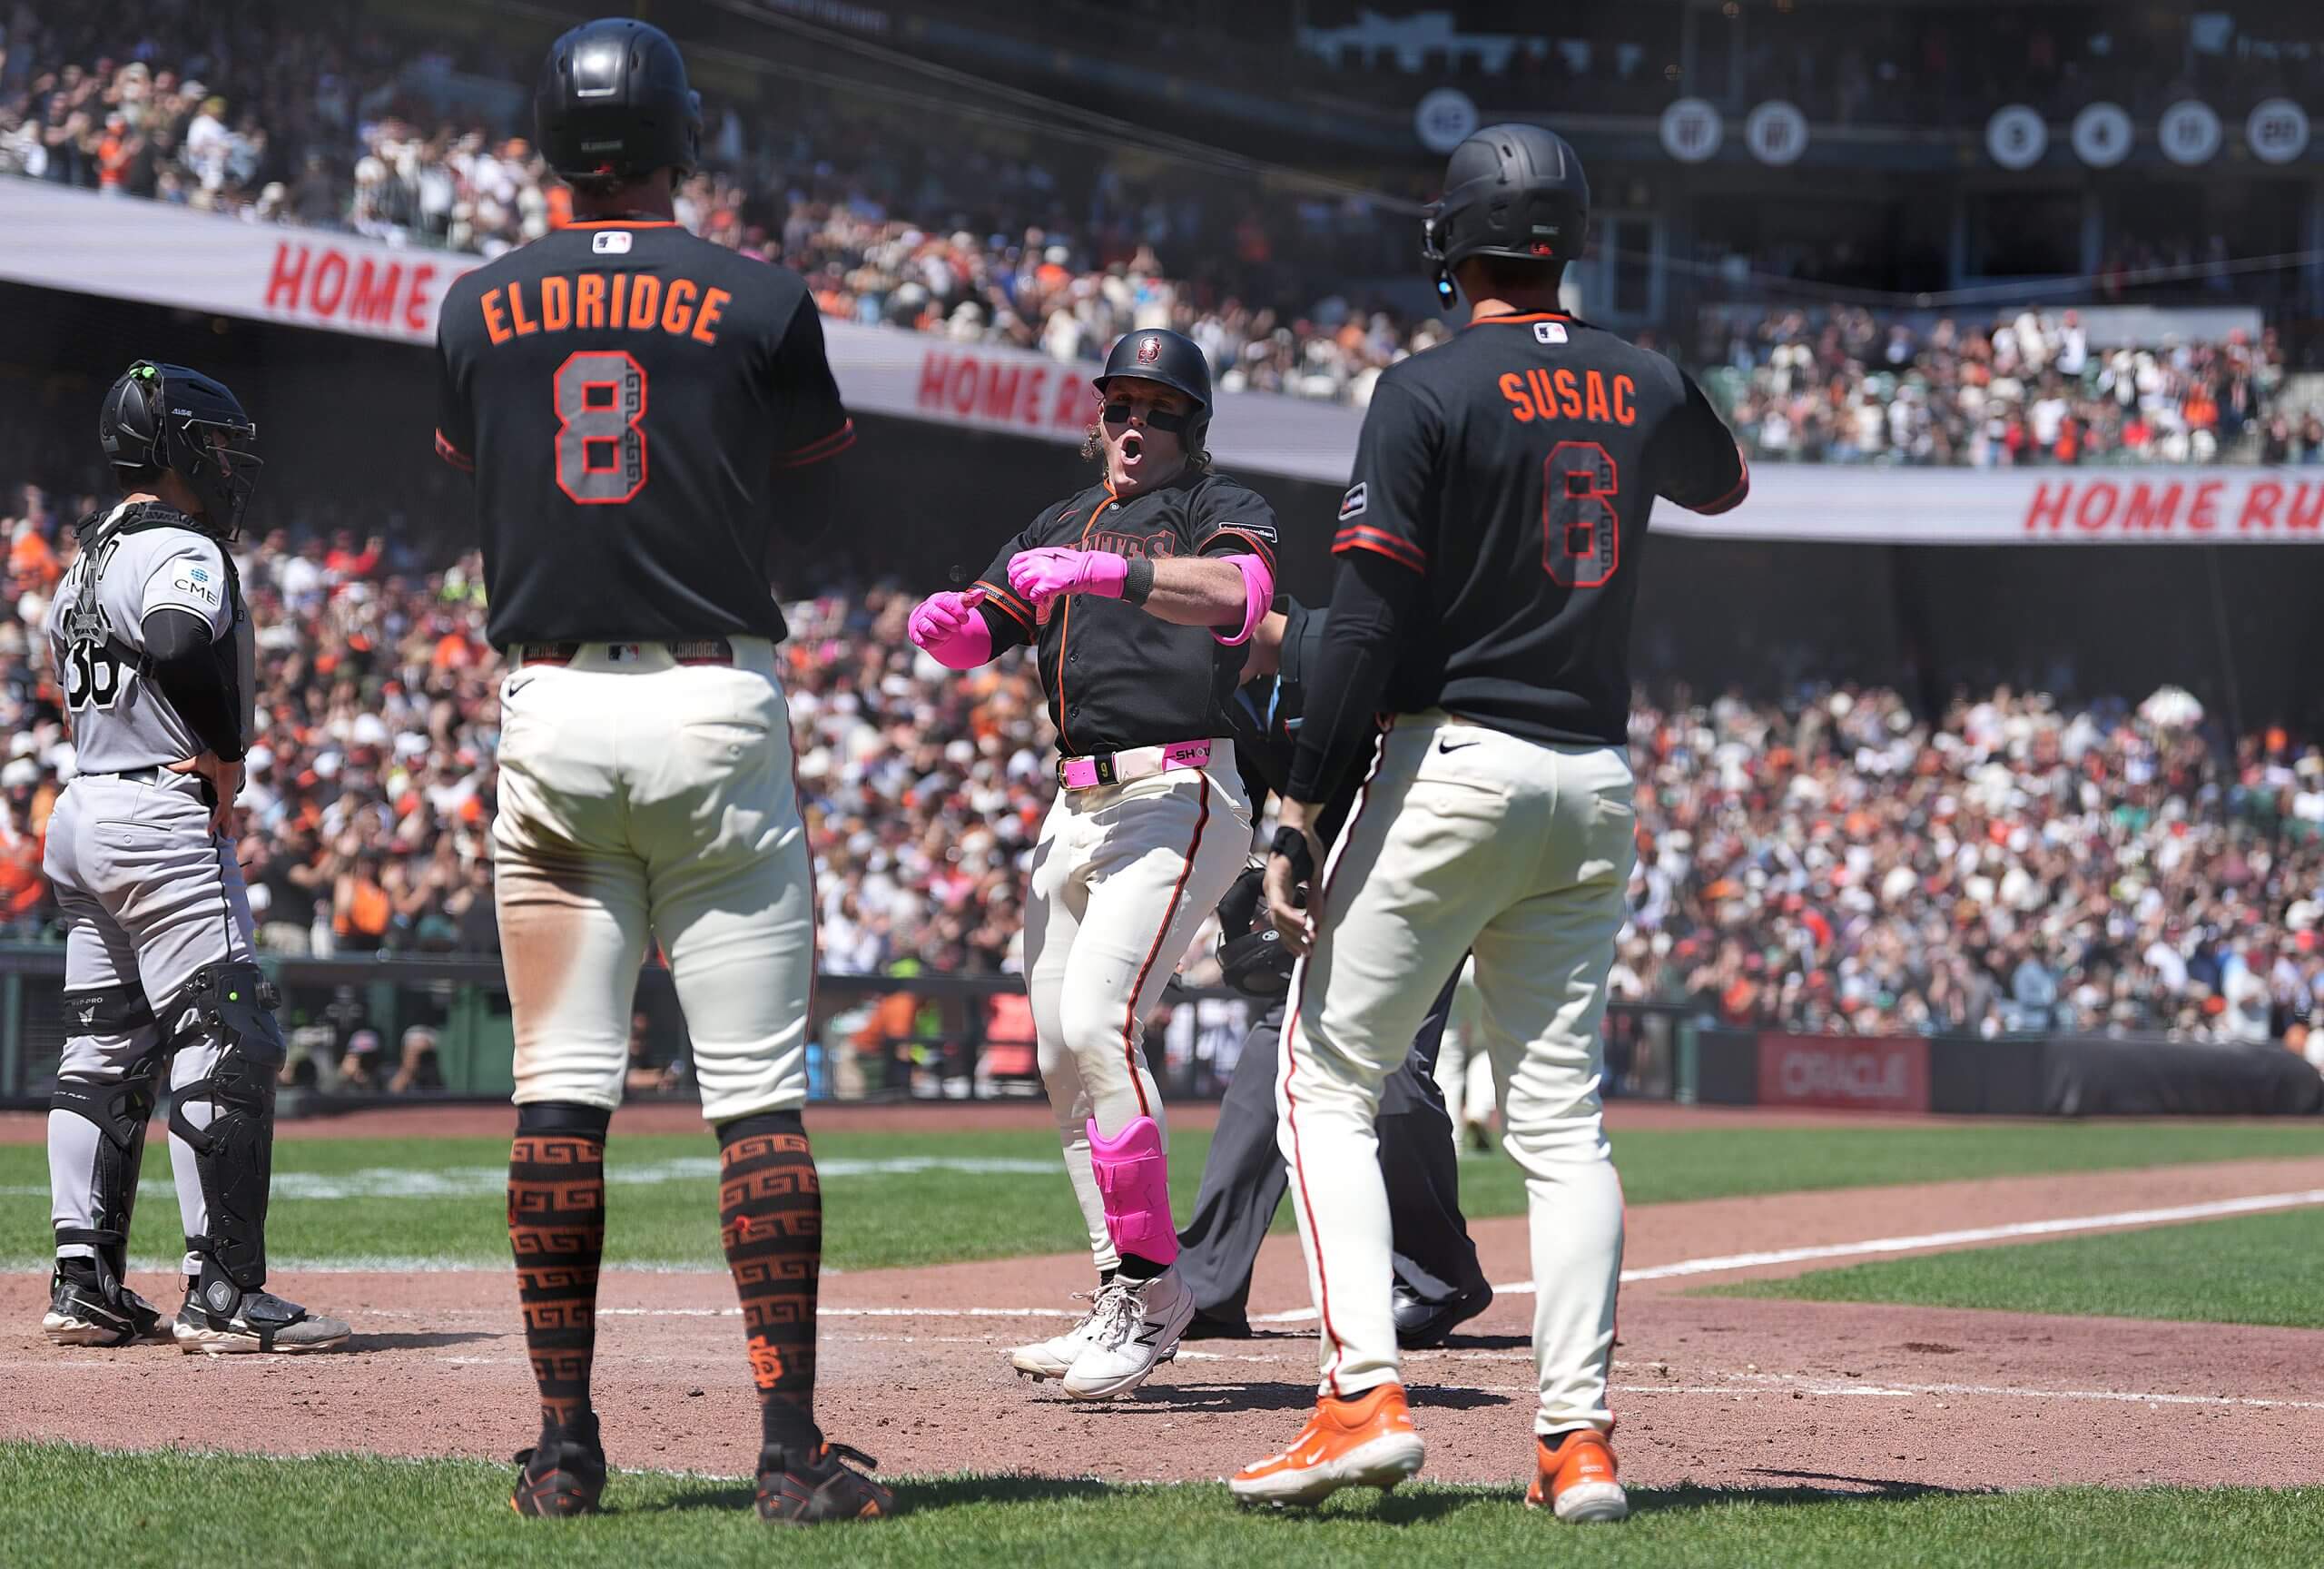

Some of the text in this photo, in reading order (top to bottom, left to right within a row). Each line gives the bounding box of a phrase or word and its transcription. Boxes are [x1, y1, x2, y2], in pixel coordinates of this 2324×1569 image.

[264, 241, 437, 331] HOME
[480, 273, 732, 346] ELDRIDGE
[917, 350, 1046, 427] HOME
[1499, 368, 1636, 426] SUSAC
[553, 350, 648, 505] 8
[1542, 440, 1619, 587] 6
[2024, 479, 2225, 531] HOME
[174, 578, 219, 605] CME
[1099, 762, 1109, 778] 9
[1780, 1051, 1906, 1098] ORACLE
